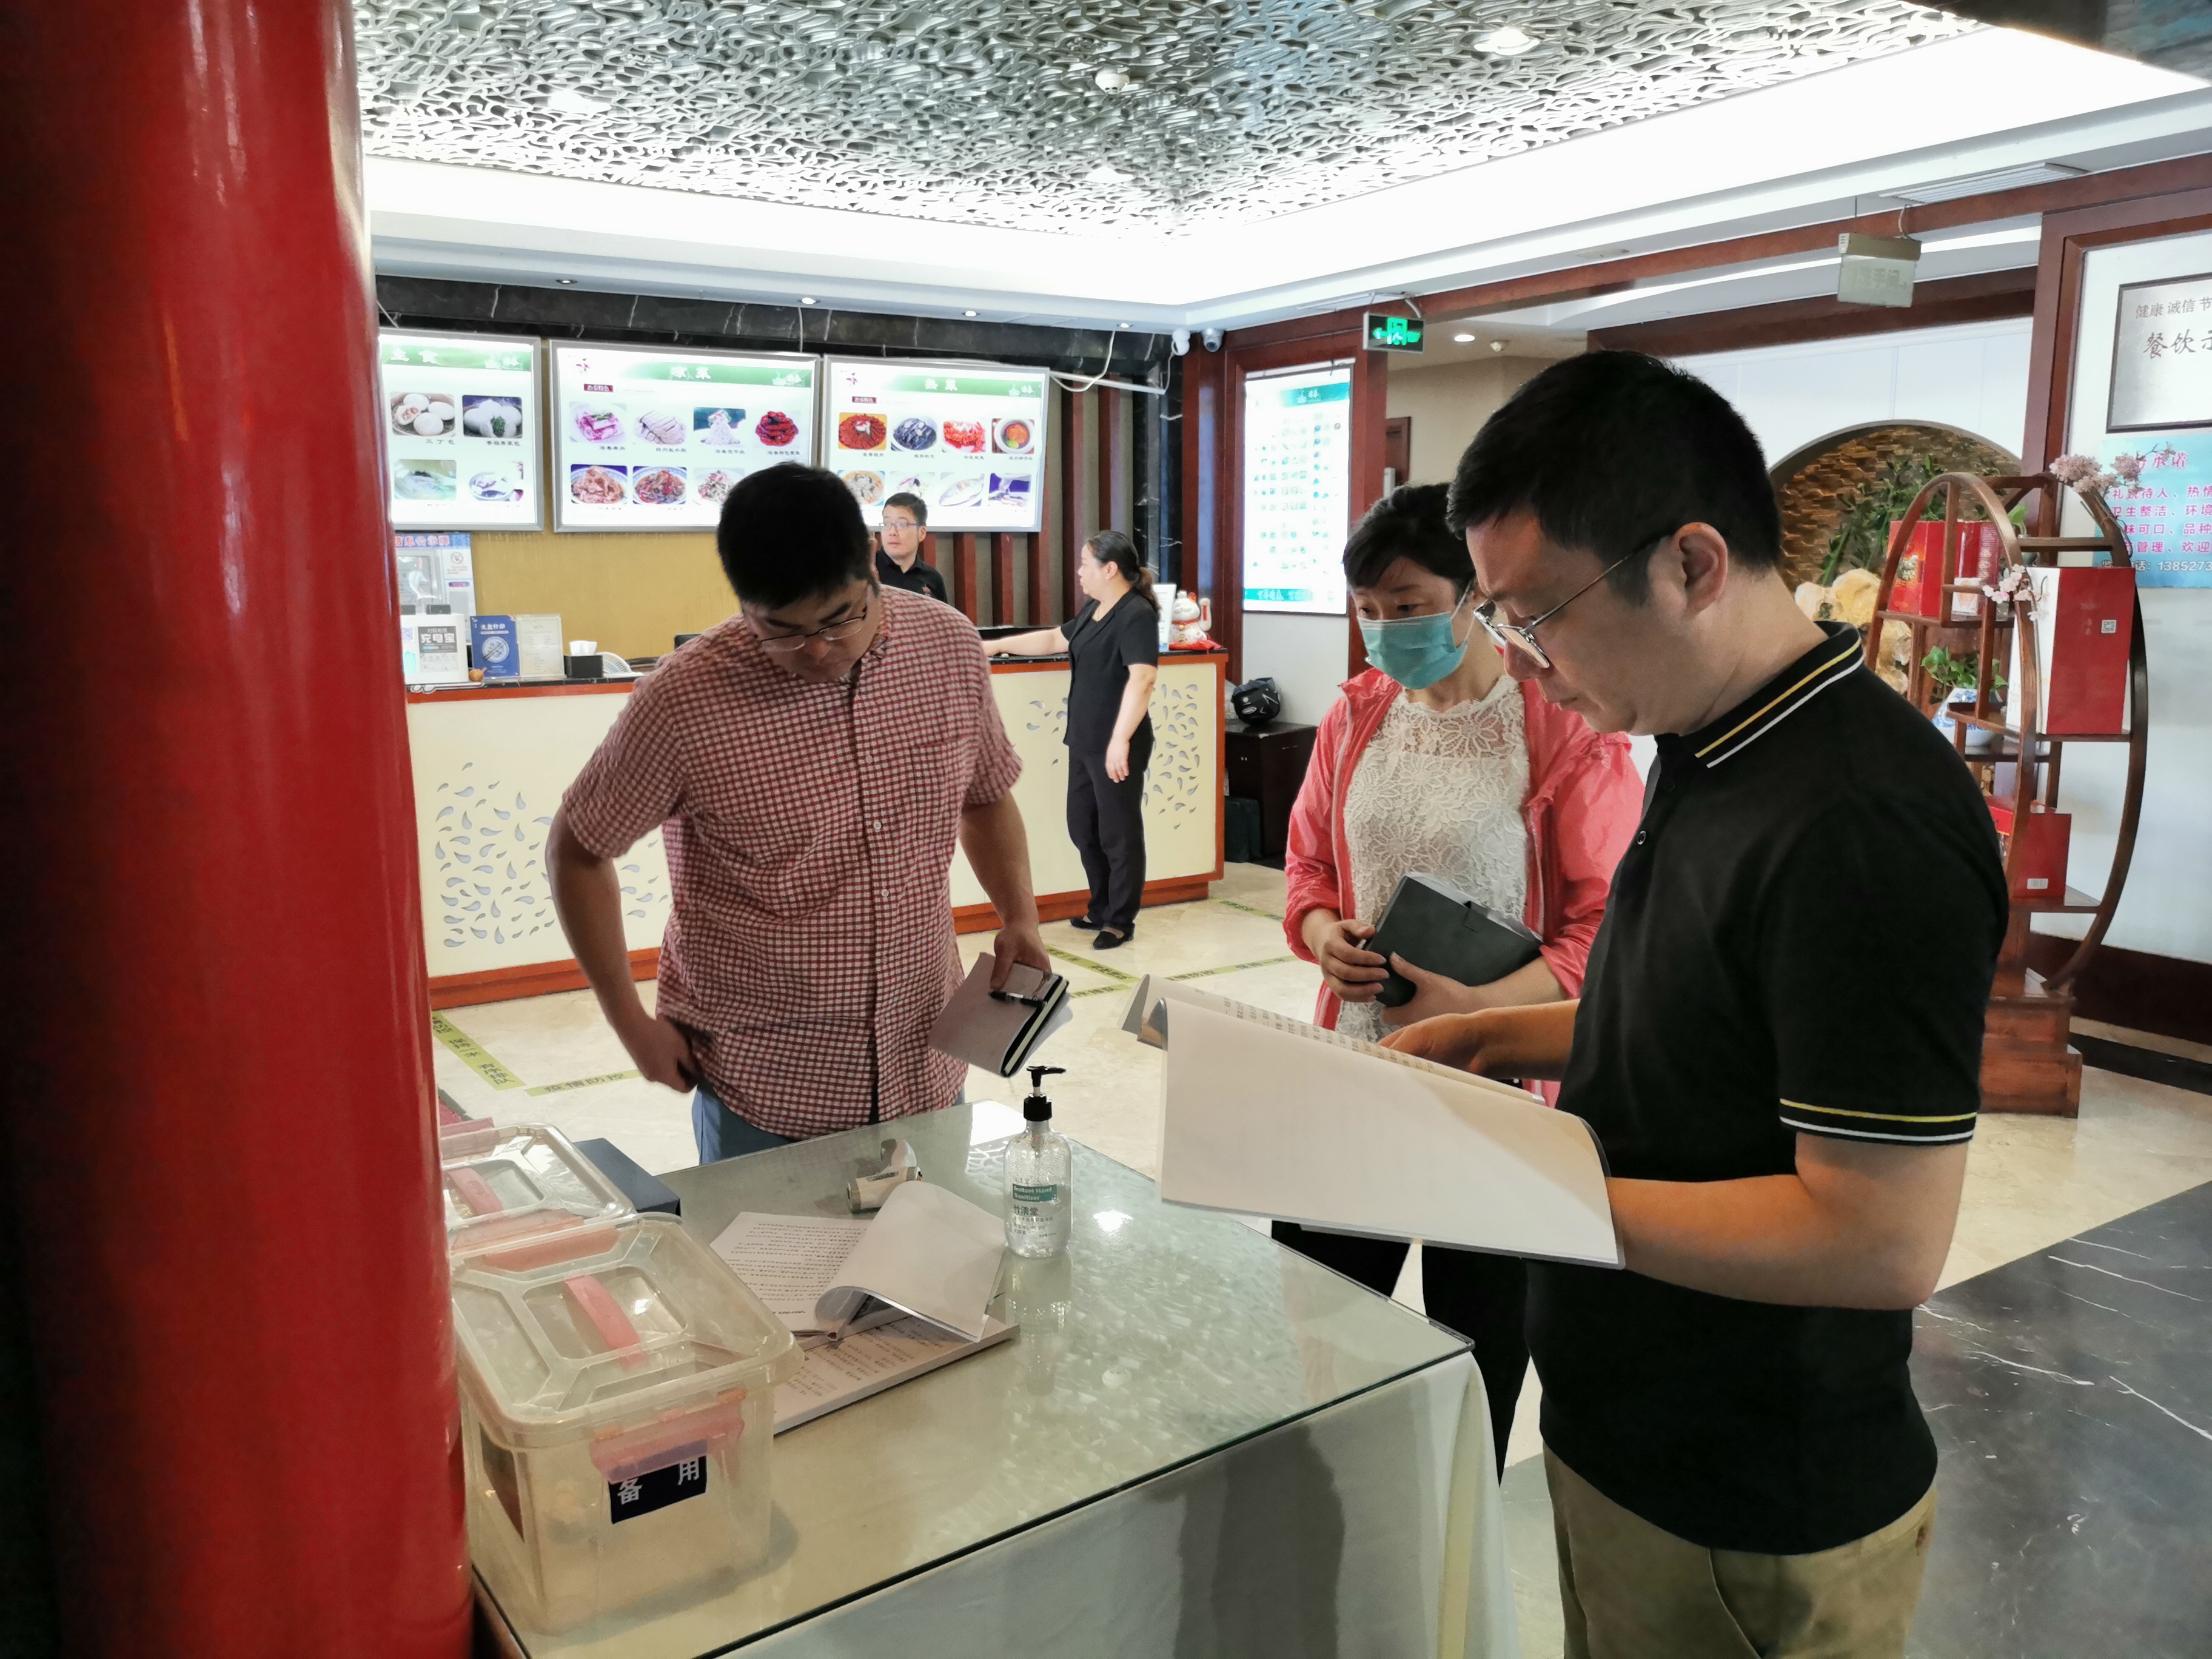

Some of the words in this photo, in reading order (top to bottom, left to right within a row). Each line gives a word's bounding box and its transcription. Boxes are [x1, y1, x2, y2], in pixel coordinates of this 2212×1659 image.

[420, 633, 455, 643] 充电宝
[1014, 1185, 1034, 1193] Instant
